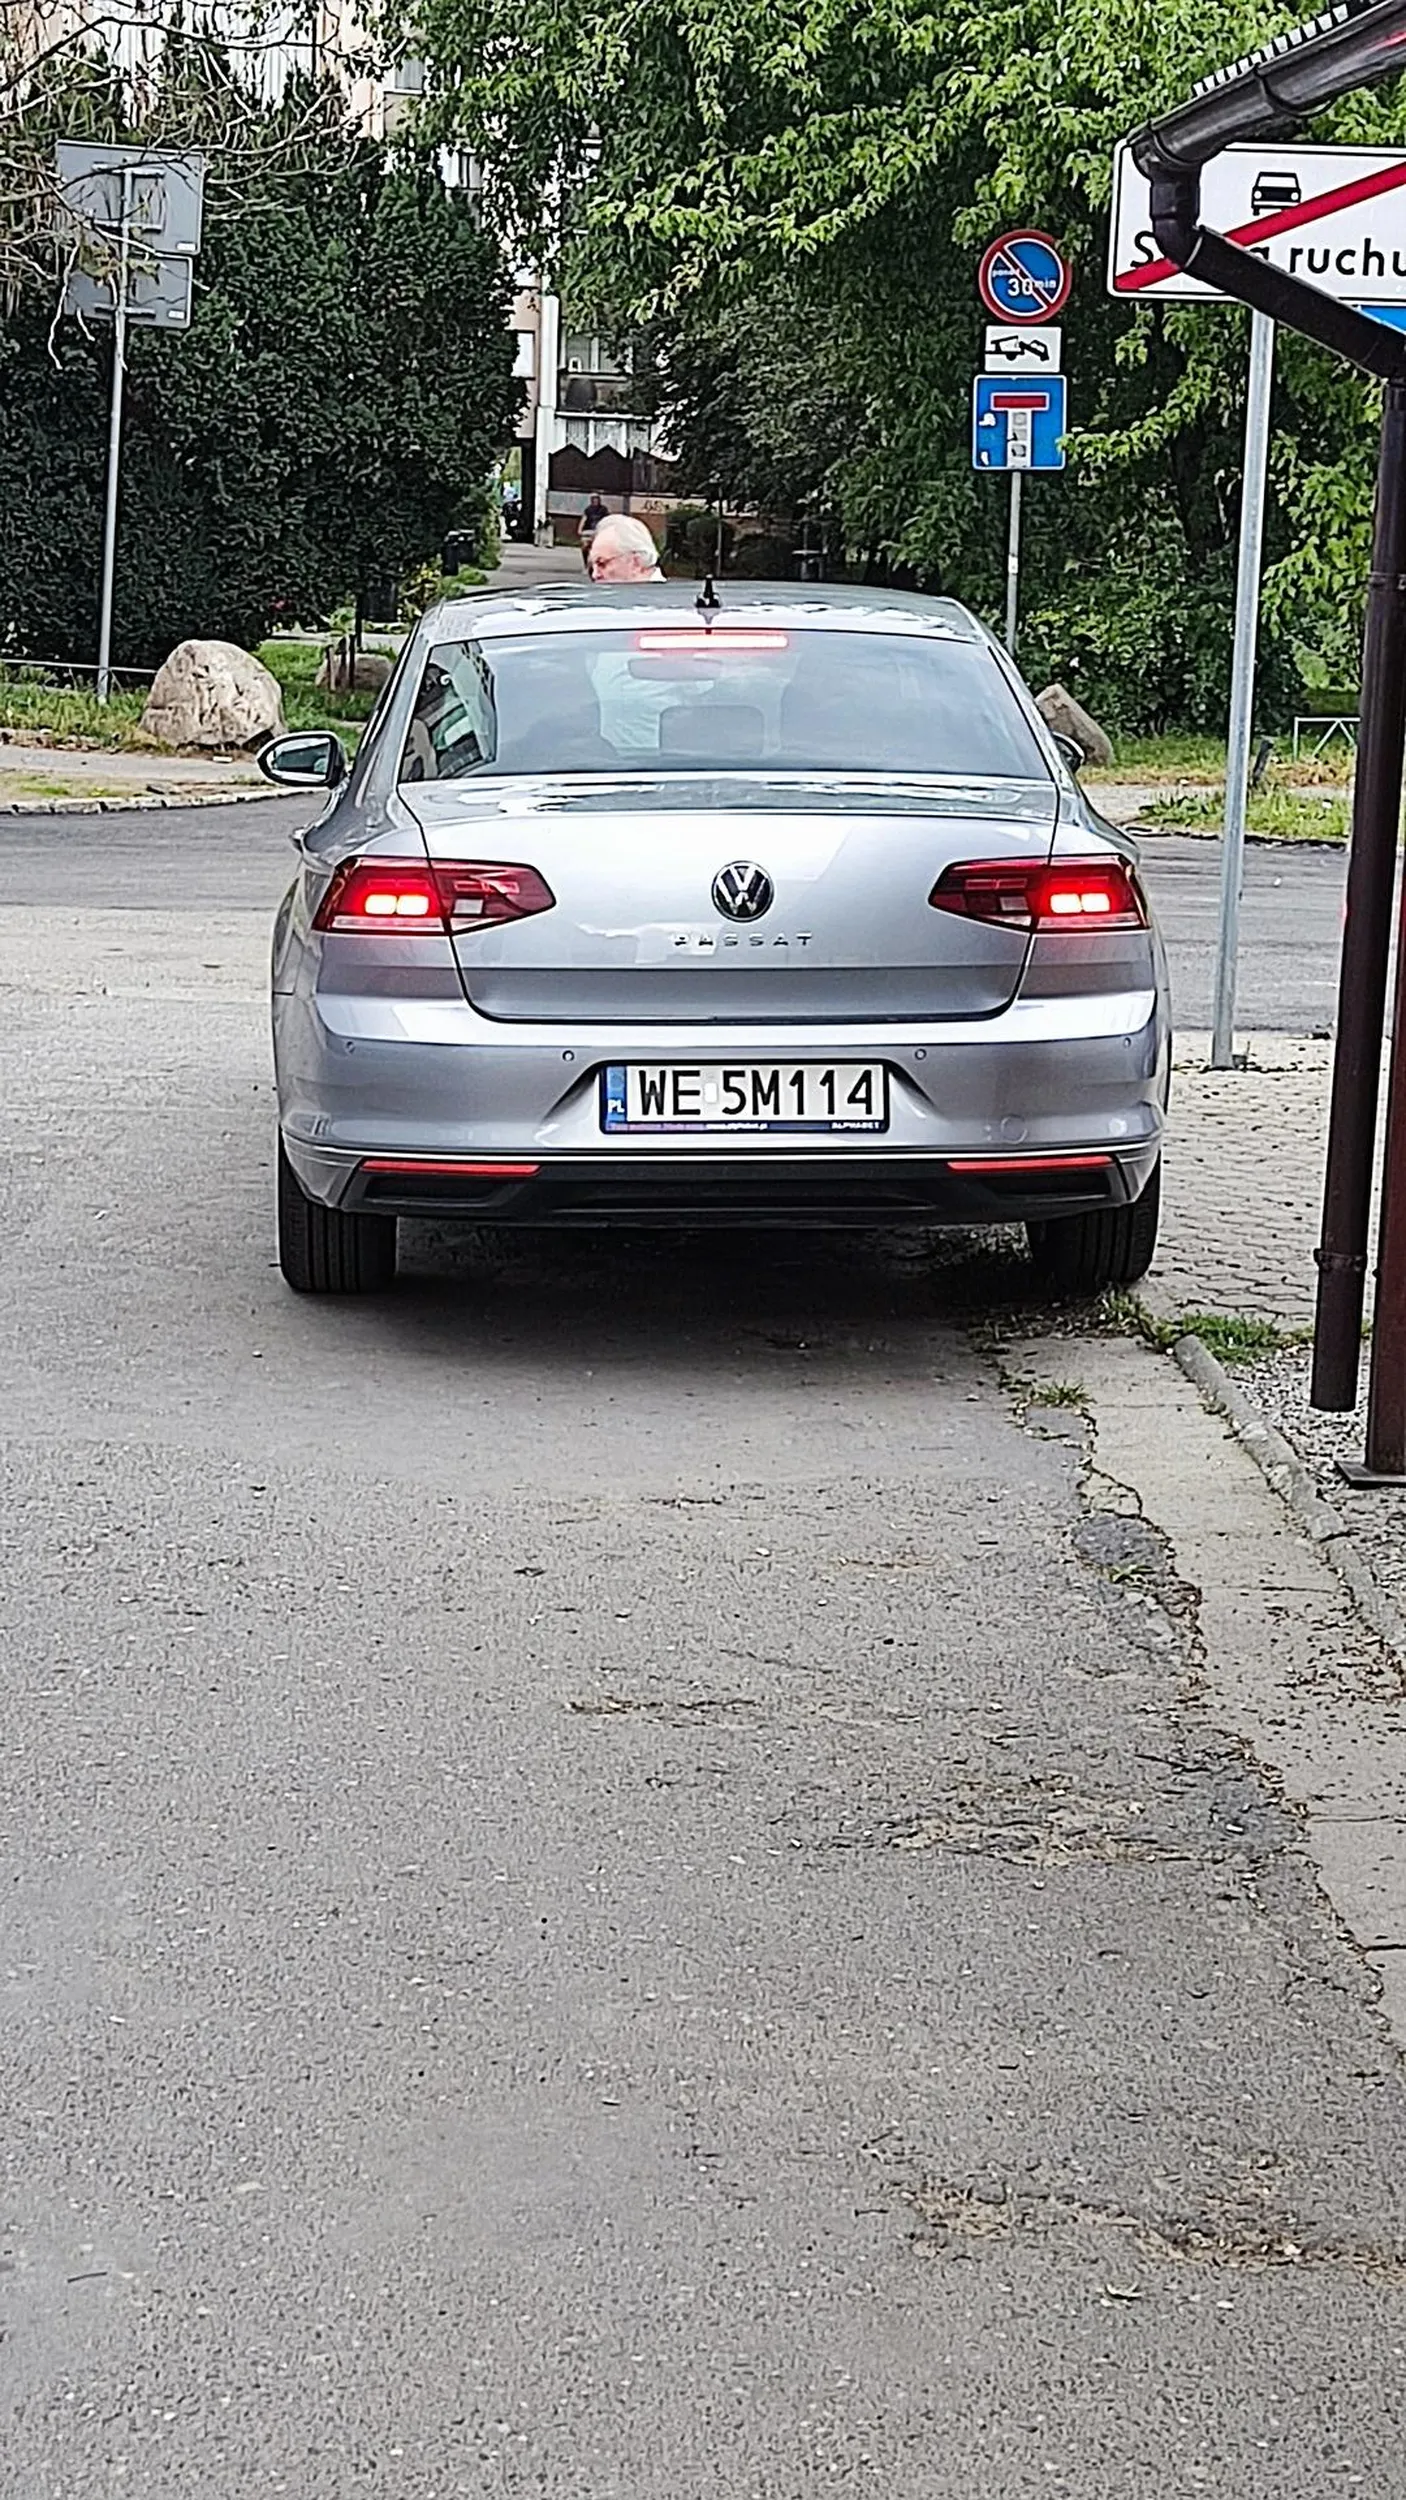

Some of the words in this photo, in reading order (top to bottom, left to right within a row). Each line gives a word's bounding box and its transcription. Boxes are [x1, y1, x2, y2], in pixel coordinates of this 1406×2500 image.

[1289, 237, 1406, 277] ruchu
[1007, 278, 1033, 297] 30
[674, 931, 813, 947] PASSAT
[638, 1070, 701, 1116] WE
[721, 1069, 872, 1116] 5M114
[607, 1099, 625, 1114] PL
